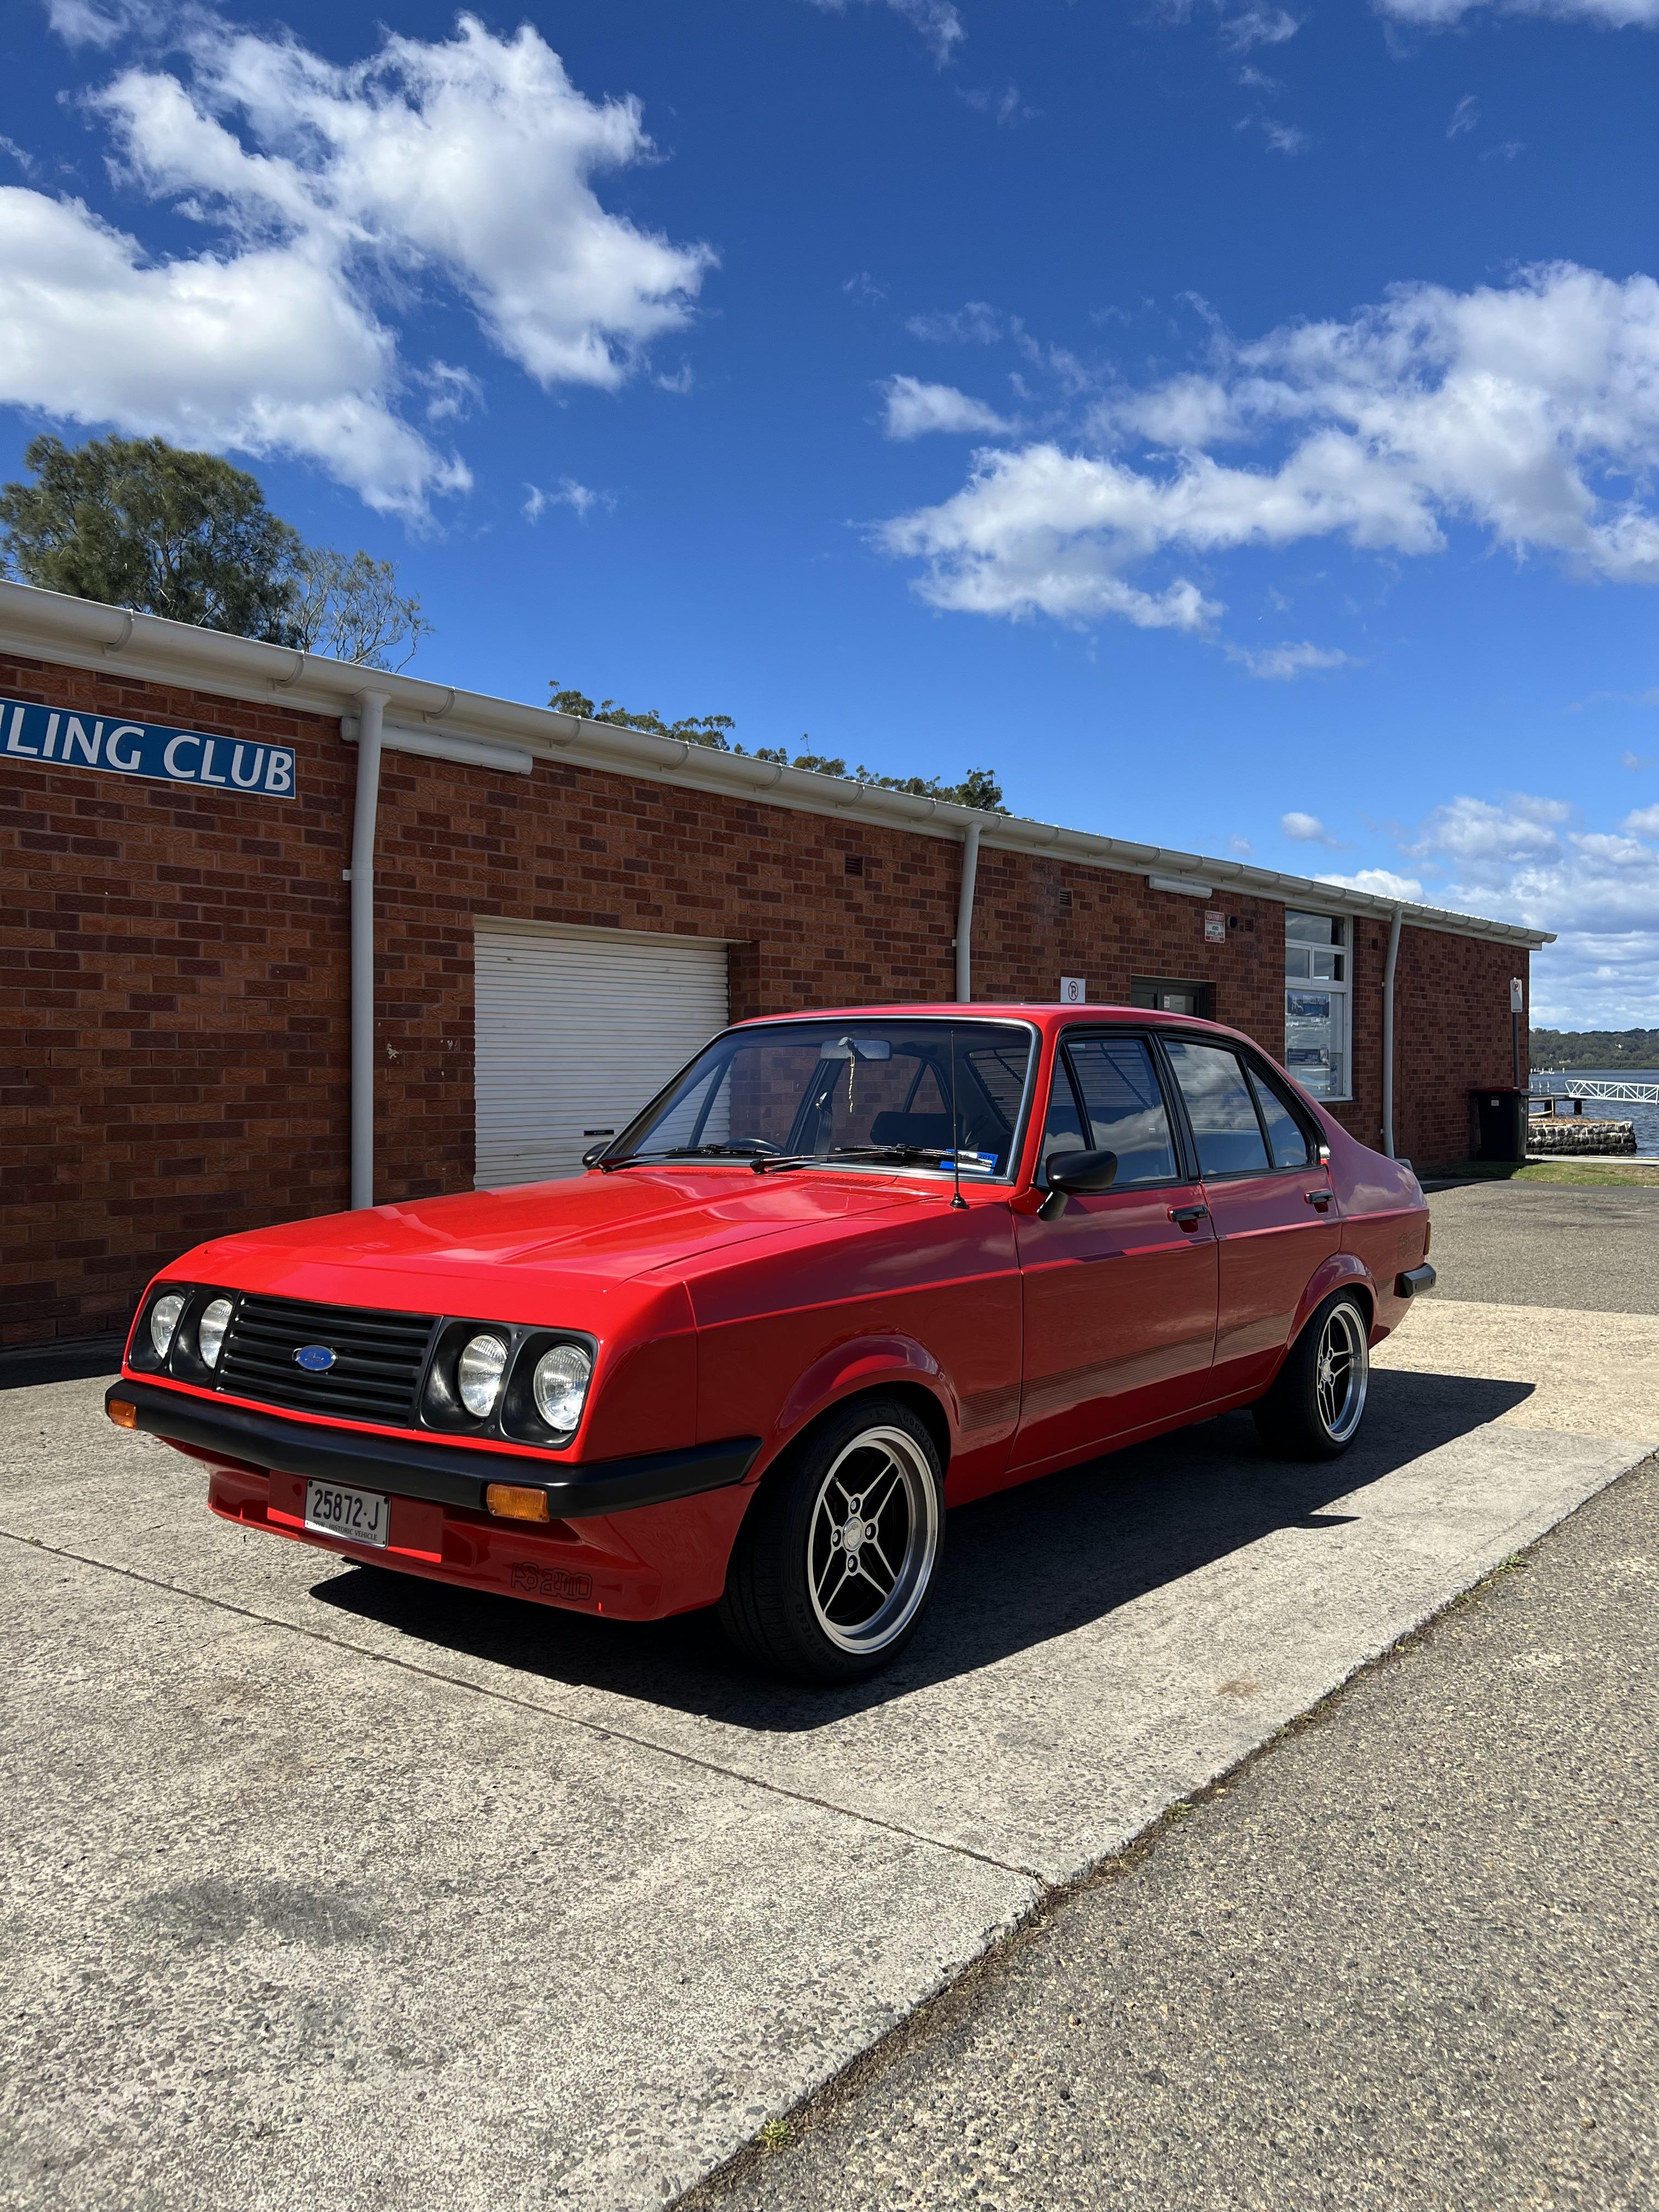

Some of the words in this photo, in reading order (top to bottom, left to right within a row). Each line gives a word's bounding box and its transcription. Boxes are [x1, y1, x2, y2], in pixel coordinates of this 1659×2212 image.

[0, 704, 145, 770] LING
[163, 735, 292, 792] CLUB
[1206, 913, 1224, 922] WARNING
[903, 1413, 941, 1480] GOODYEAR
[329, 1523, 354, 1536] HISTORIC
[354, 1530, 378, 1541] VEHICLE
